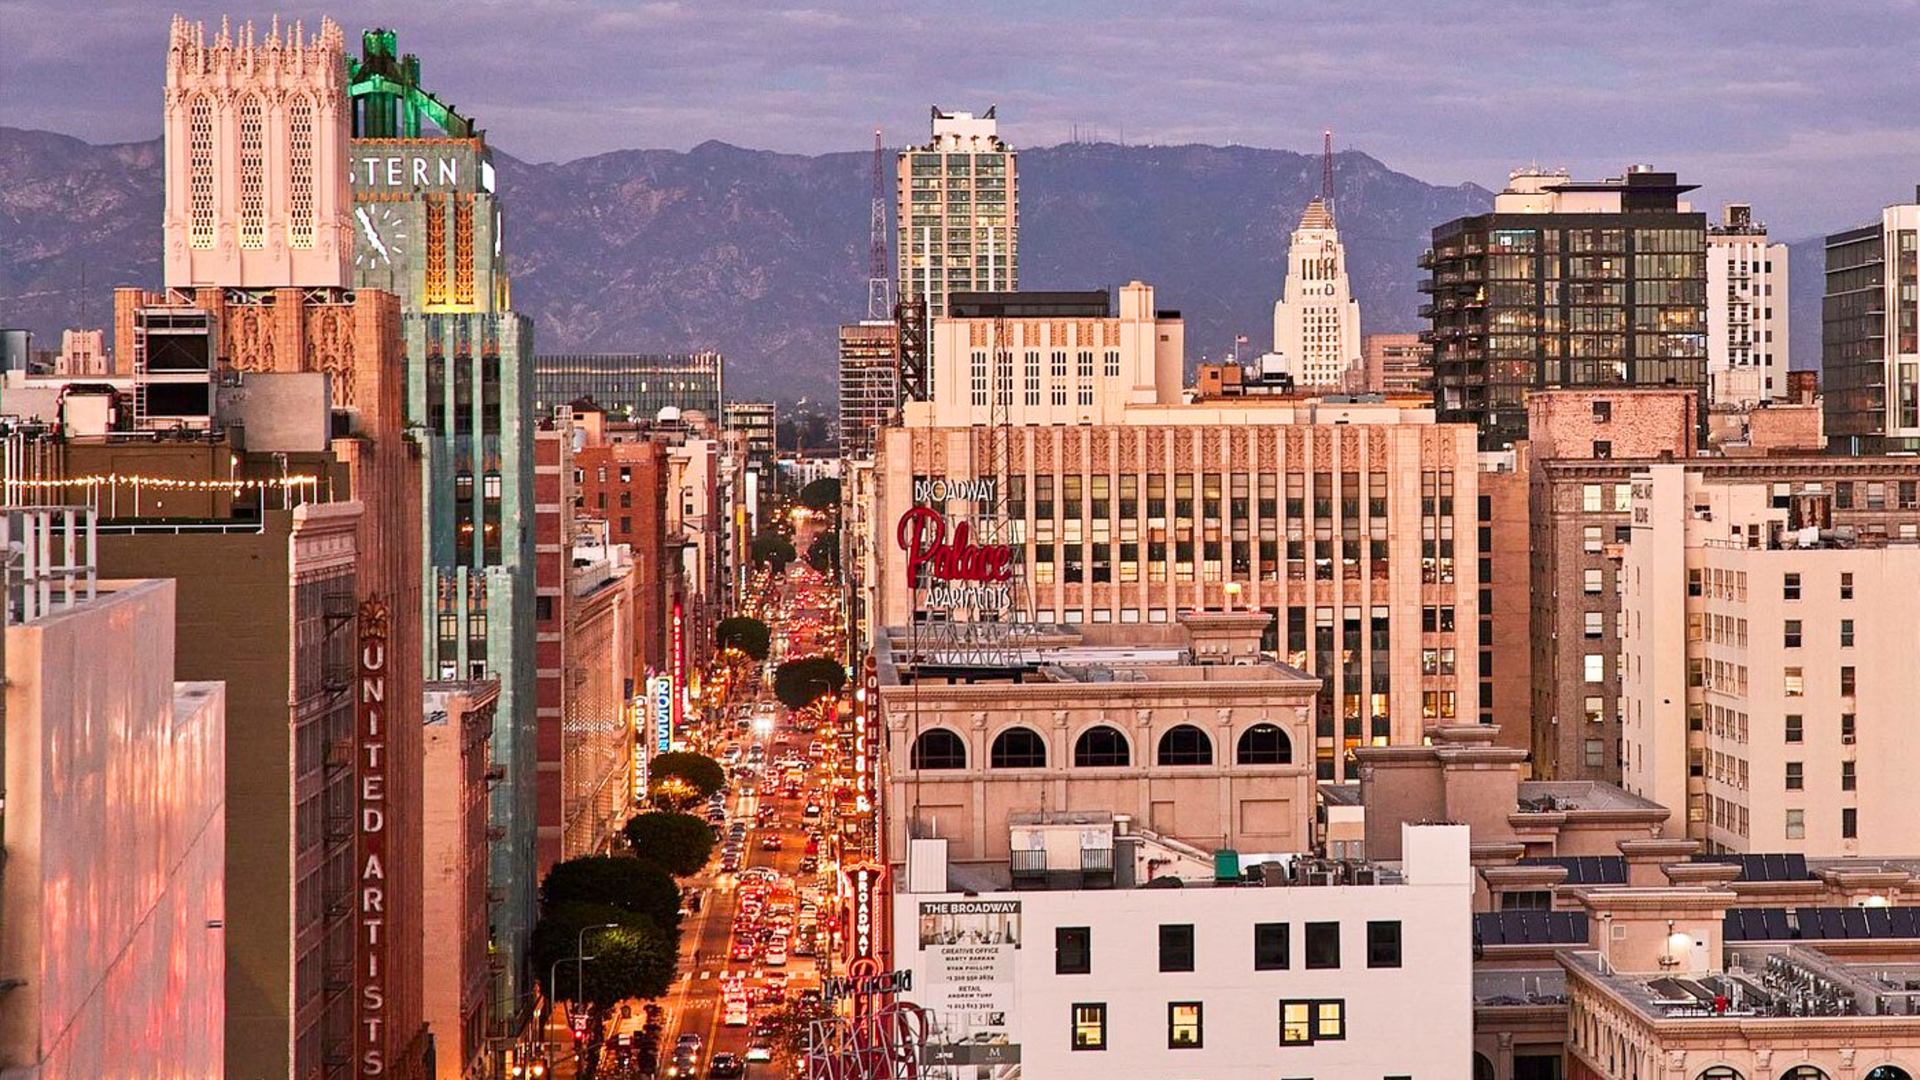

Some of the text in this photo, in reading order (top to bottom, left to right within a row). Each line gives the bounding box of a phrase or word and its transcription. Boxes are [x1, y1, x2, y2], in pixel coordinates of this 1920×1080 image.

[915, 480, 996, 501] BROADWAY
[897, 507, 1011, 588] Palace
[925, 587, 1011, 609] APARTMENTS
[658, 680, 669, 739] ROSS
[636, 700, 645, 795] FOOT LOCKER
[362, 643, 385, 1076] UNITED ARTISTS
[857, 871, 870, 957] BROADWAY
[925, 903, 1016, 913] THE BROADWAY
